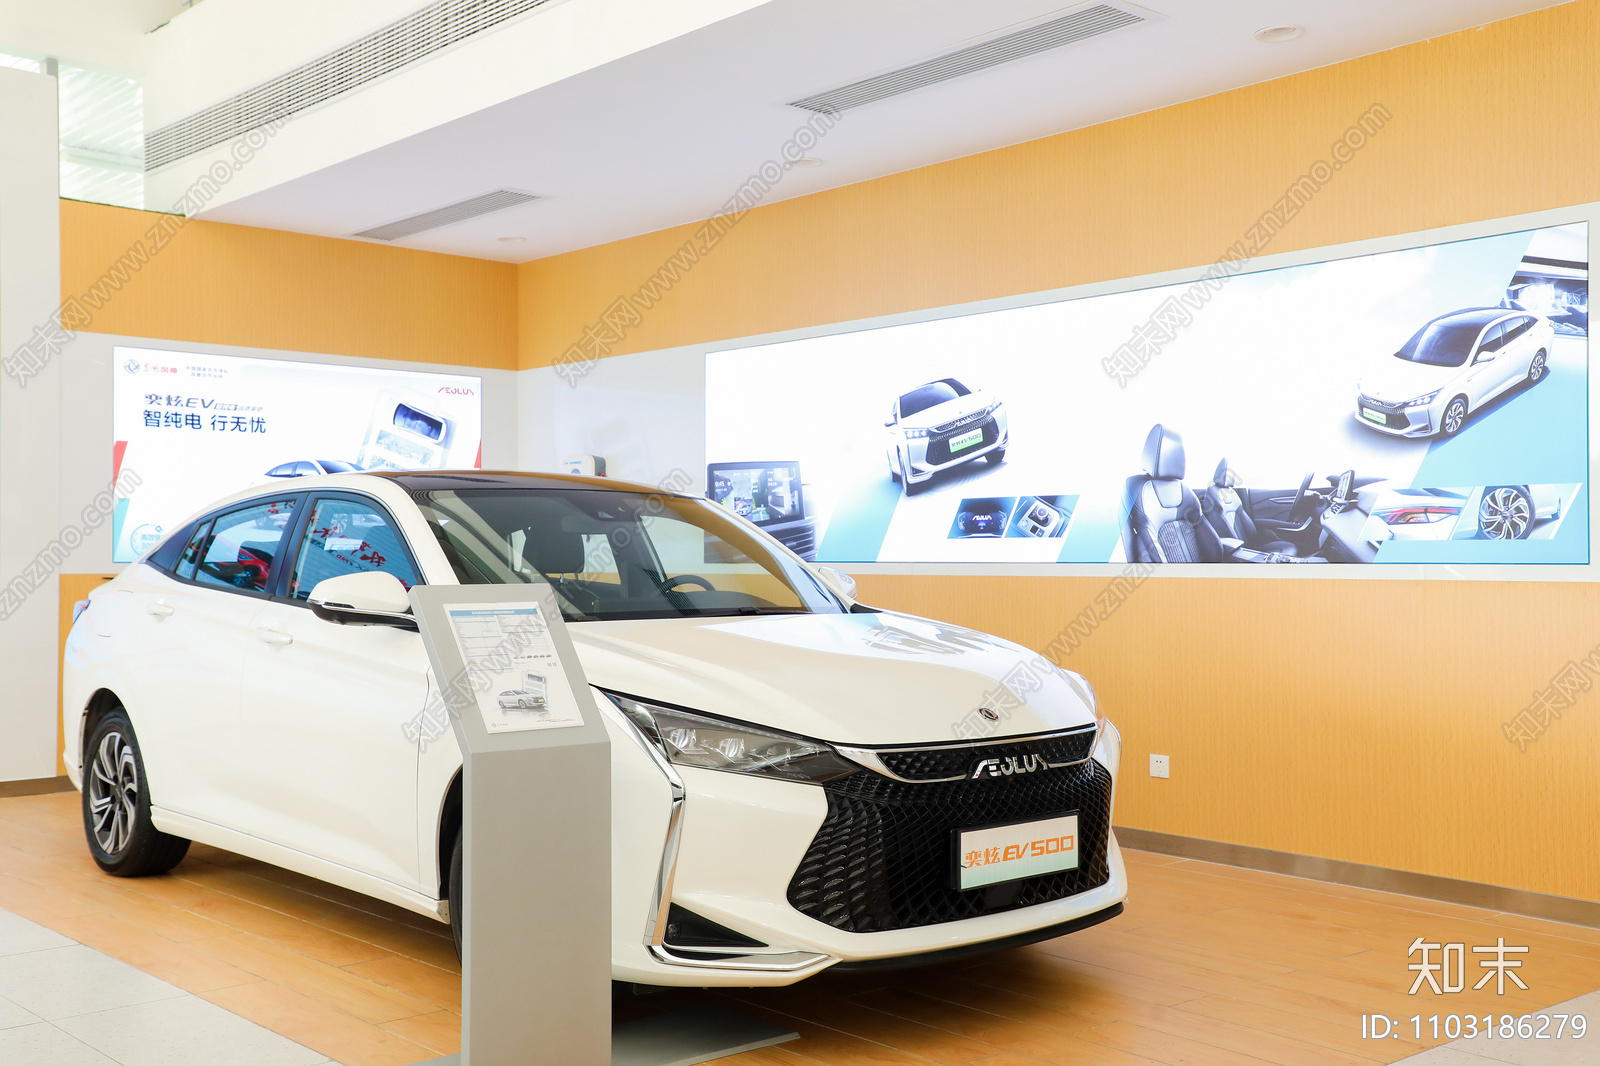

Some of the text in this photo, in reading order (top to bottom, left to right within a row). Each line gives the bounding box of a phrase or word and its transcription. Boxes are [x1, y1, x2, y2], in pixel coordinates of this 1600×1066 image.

[143, 410, 266, 434] 智纯电 行无忧
[971, 753, 1049, 779] AEOLUS
